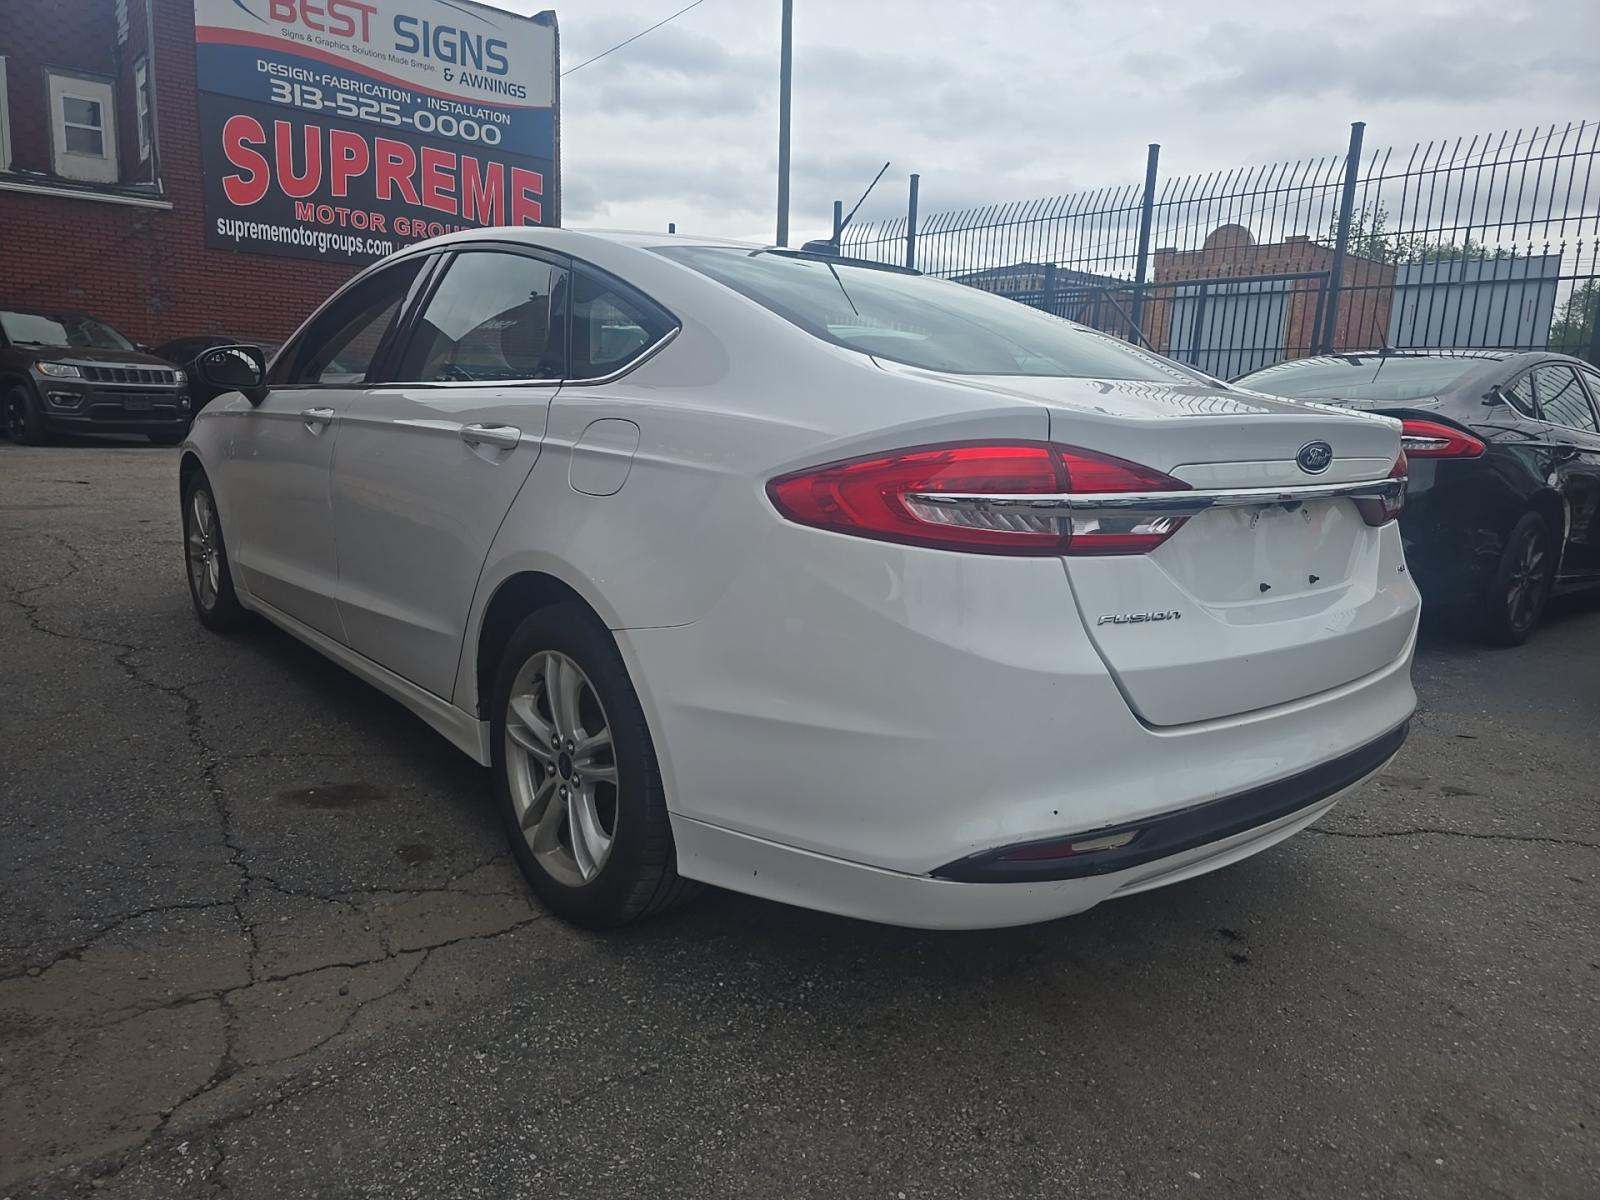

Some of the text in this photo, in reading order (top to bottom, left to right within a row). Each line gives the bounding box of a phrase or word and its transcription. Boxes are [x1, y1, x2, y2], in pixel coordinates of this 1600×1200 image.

[269, 0, 509, 76] BEST SIGNS
[280, 27, 305, 41] Signs
[315, 36, 350, 52] Graphics
[352, 44, 387, 61] Solutions
[388, 53, 409, 66] Made
[257, 60, 511, 125] DESIGN FABRICATION INSTALLATION
[443, 68, 527, 99] & AWNINGS
[270, 78, 502, 145] 313-525-0000
[222, 114, 543, 228] SUPREME
[216, 216, 393, 256] suprememotorgroups.com
[295, 202, 471, 239] MOTOR GROU
